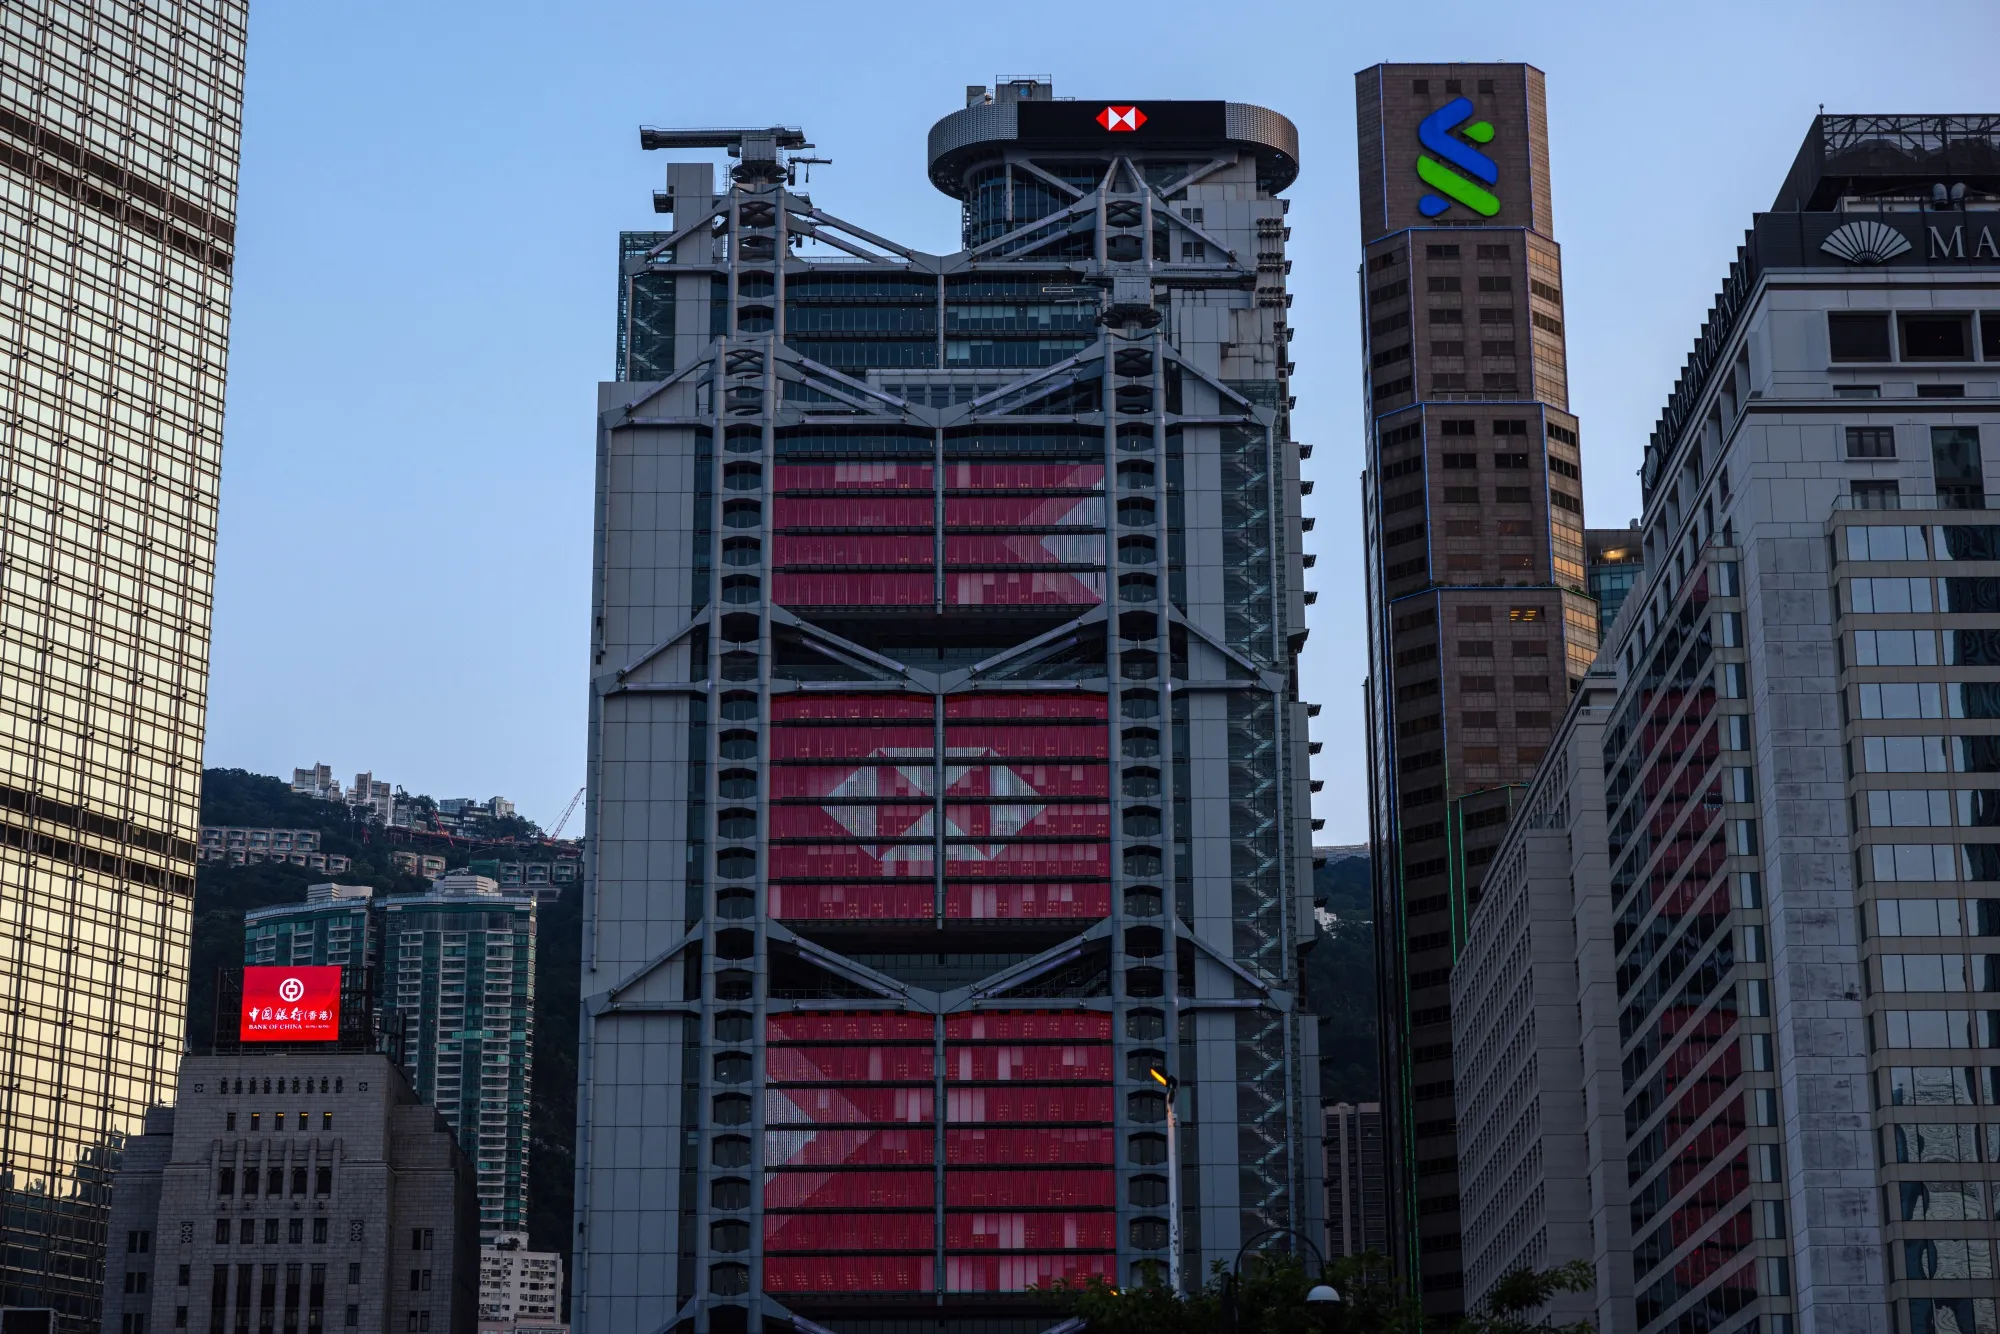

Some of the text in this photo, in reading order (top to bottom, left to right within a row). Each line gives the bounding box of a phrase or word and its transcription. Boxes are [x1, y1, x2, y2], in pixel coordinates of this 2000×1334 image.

[1928, 225, 2000, 258] MA
[1659, 257, 1750, 463] MANDARIN ORIENTAL
